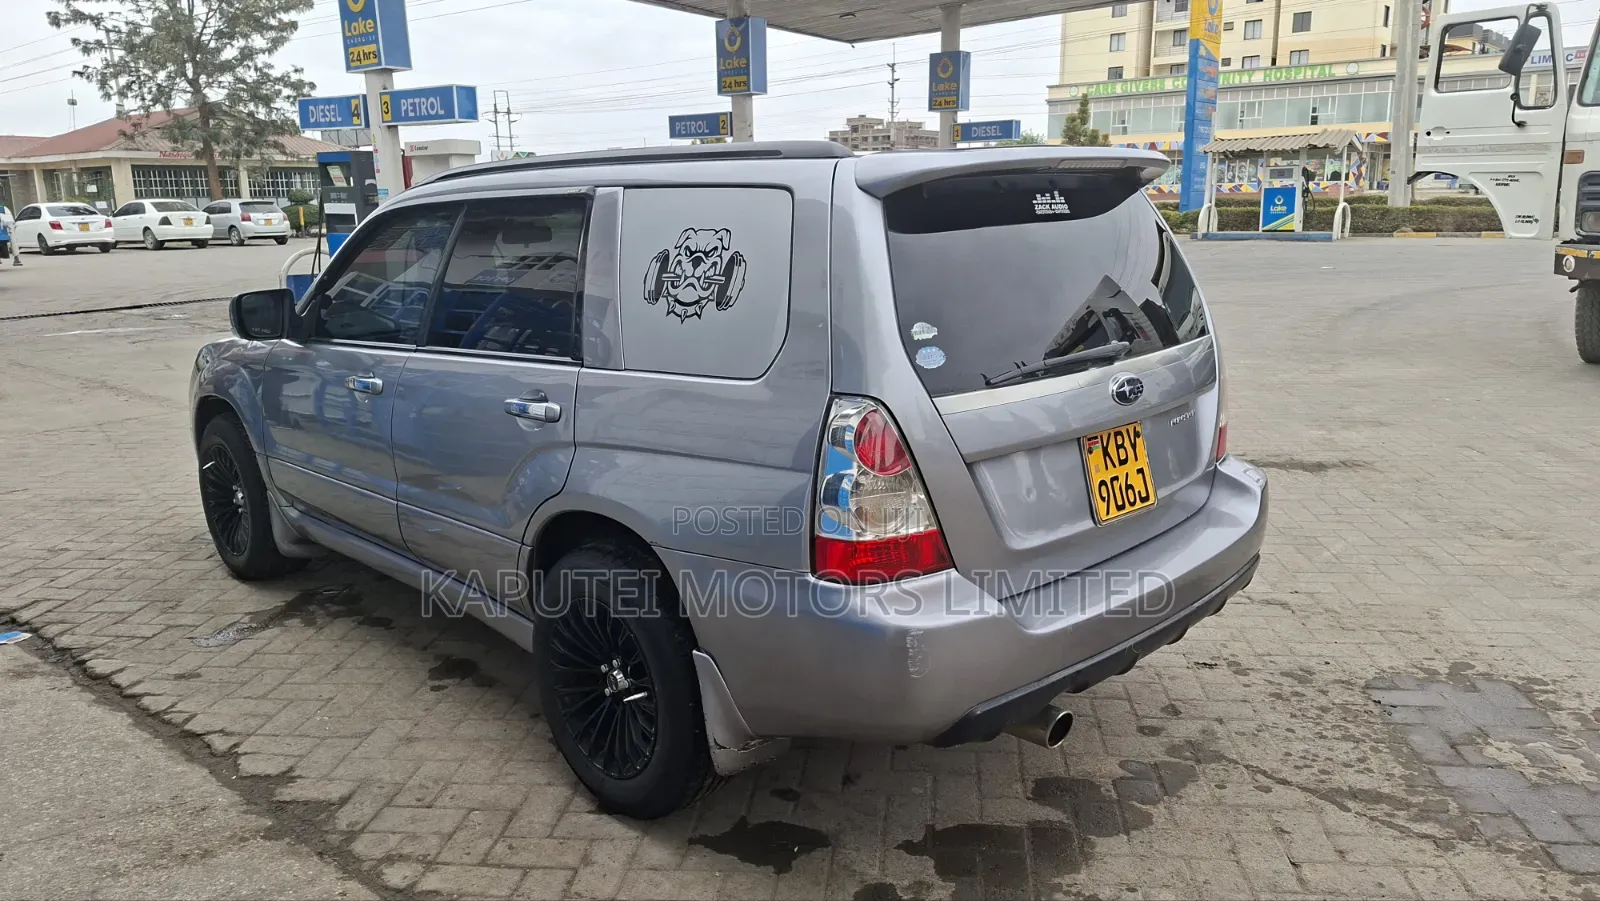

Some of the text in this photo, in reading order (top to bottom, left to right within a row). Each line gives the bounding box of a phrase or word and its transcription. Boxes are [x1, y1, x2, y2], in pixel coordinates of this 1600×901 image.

[345, 17, 375, 36] Lake
[350, 49, 378, 65] 24 hrs
[720, 56, 748, 70] Lake
[722, 79, 748, 90] 24 hrs
[932, 82, 957, 92] Lake
[1086, 82, 1117, 96] CARE
[1121, 79, 1166, 94] GIVERS
[1263, 64, 1336, 82] HOSPITAL
[383, 97, 445, 117] 3 PETROL
[932, 98, 956, 108] 24 hrs
[309, 102, 361, 123] DIESEL 4
[675, 120, 727, 135] PETROL 2
[954, 126, 1002, 138] 1 DIESEL
[1270, 204, 1288, 212] Lake
[1100, 426, 1140, 471] KBY
[1098, 467, 1150, 516] 906J
